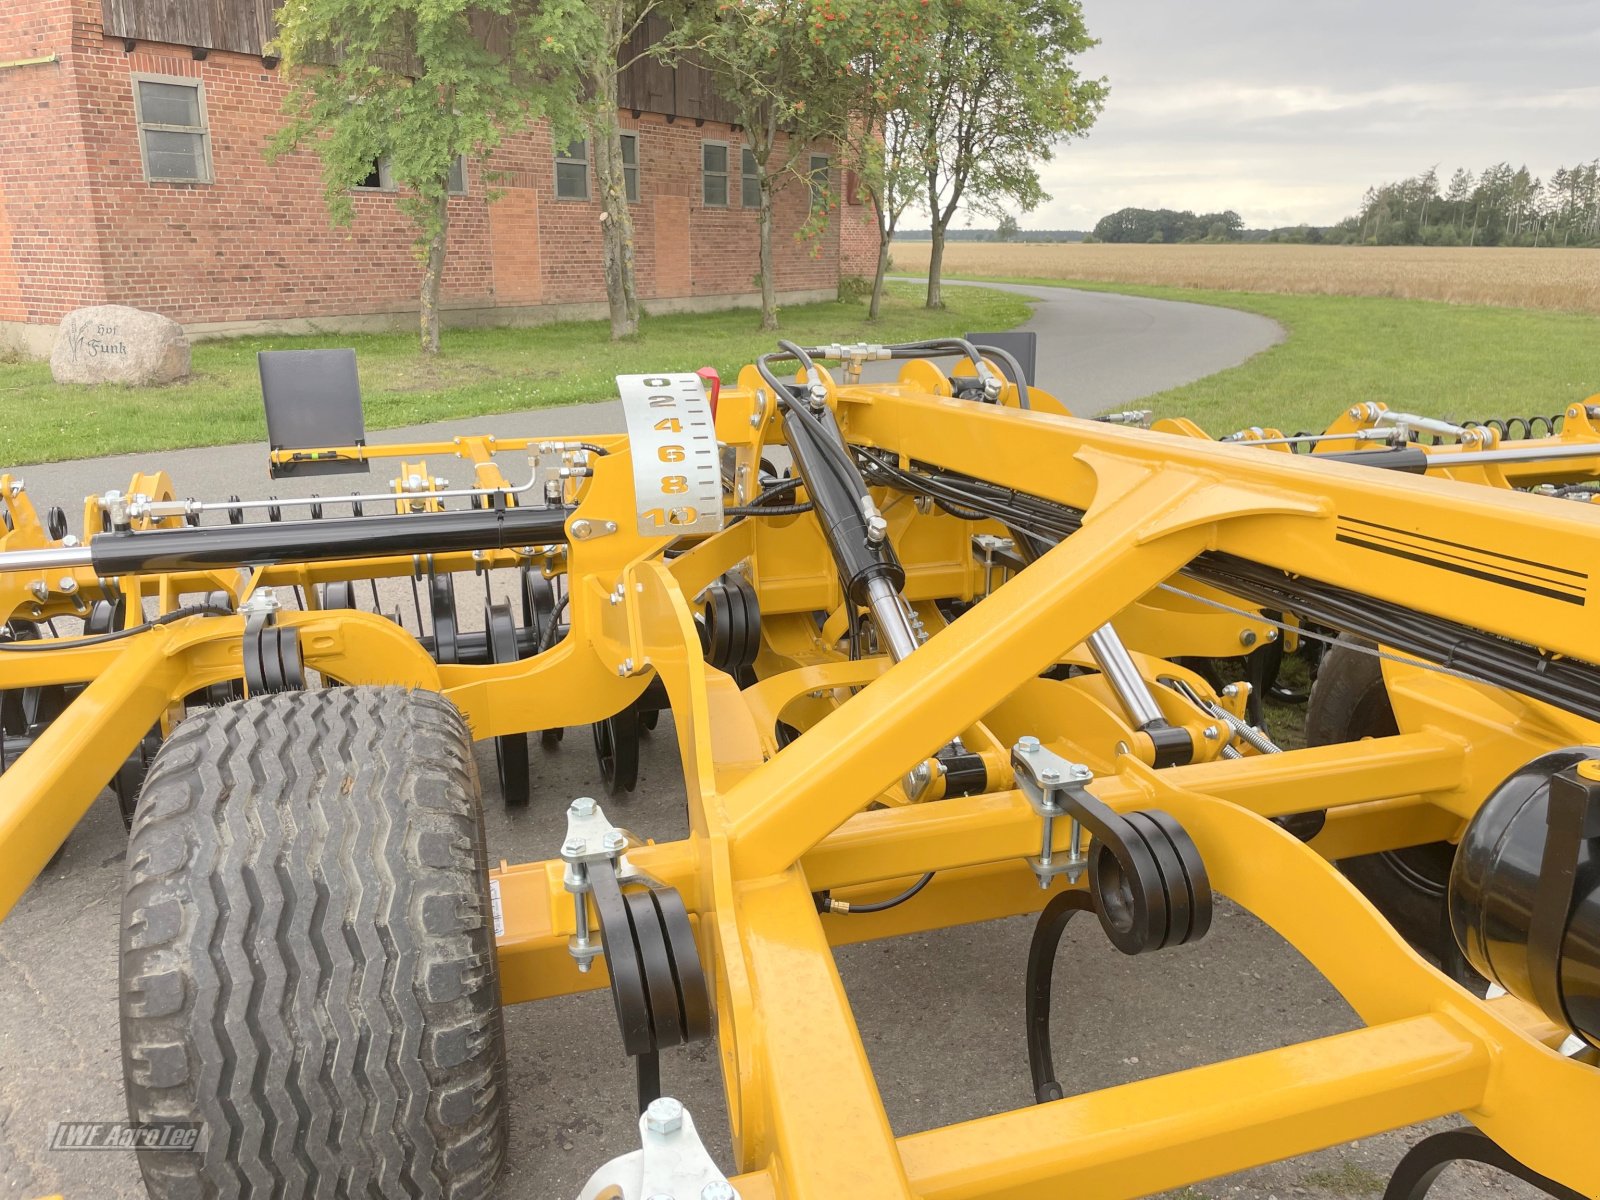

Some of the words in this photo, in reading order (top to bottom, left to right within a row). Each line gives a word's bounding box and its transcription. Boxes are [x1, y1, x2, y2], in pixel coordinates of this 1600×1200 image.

[97, 324, 118, 336] Hof
[87, 339, 127, 357] Funk
[643, 378, 671, 387] 0
[648, 396, 676, 408] 2
[654, 417, 683, 433] 4
[657, 445, 686, 463] 6
[660, 475, 689, 494] 8
[642, 507, 697, 527] 10
